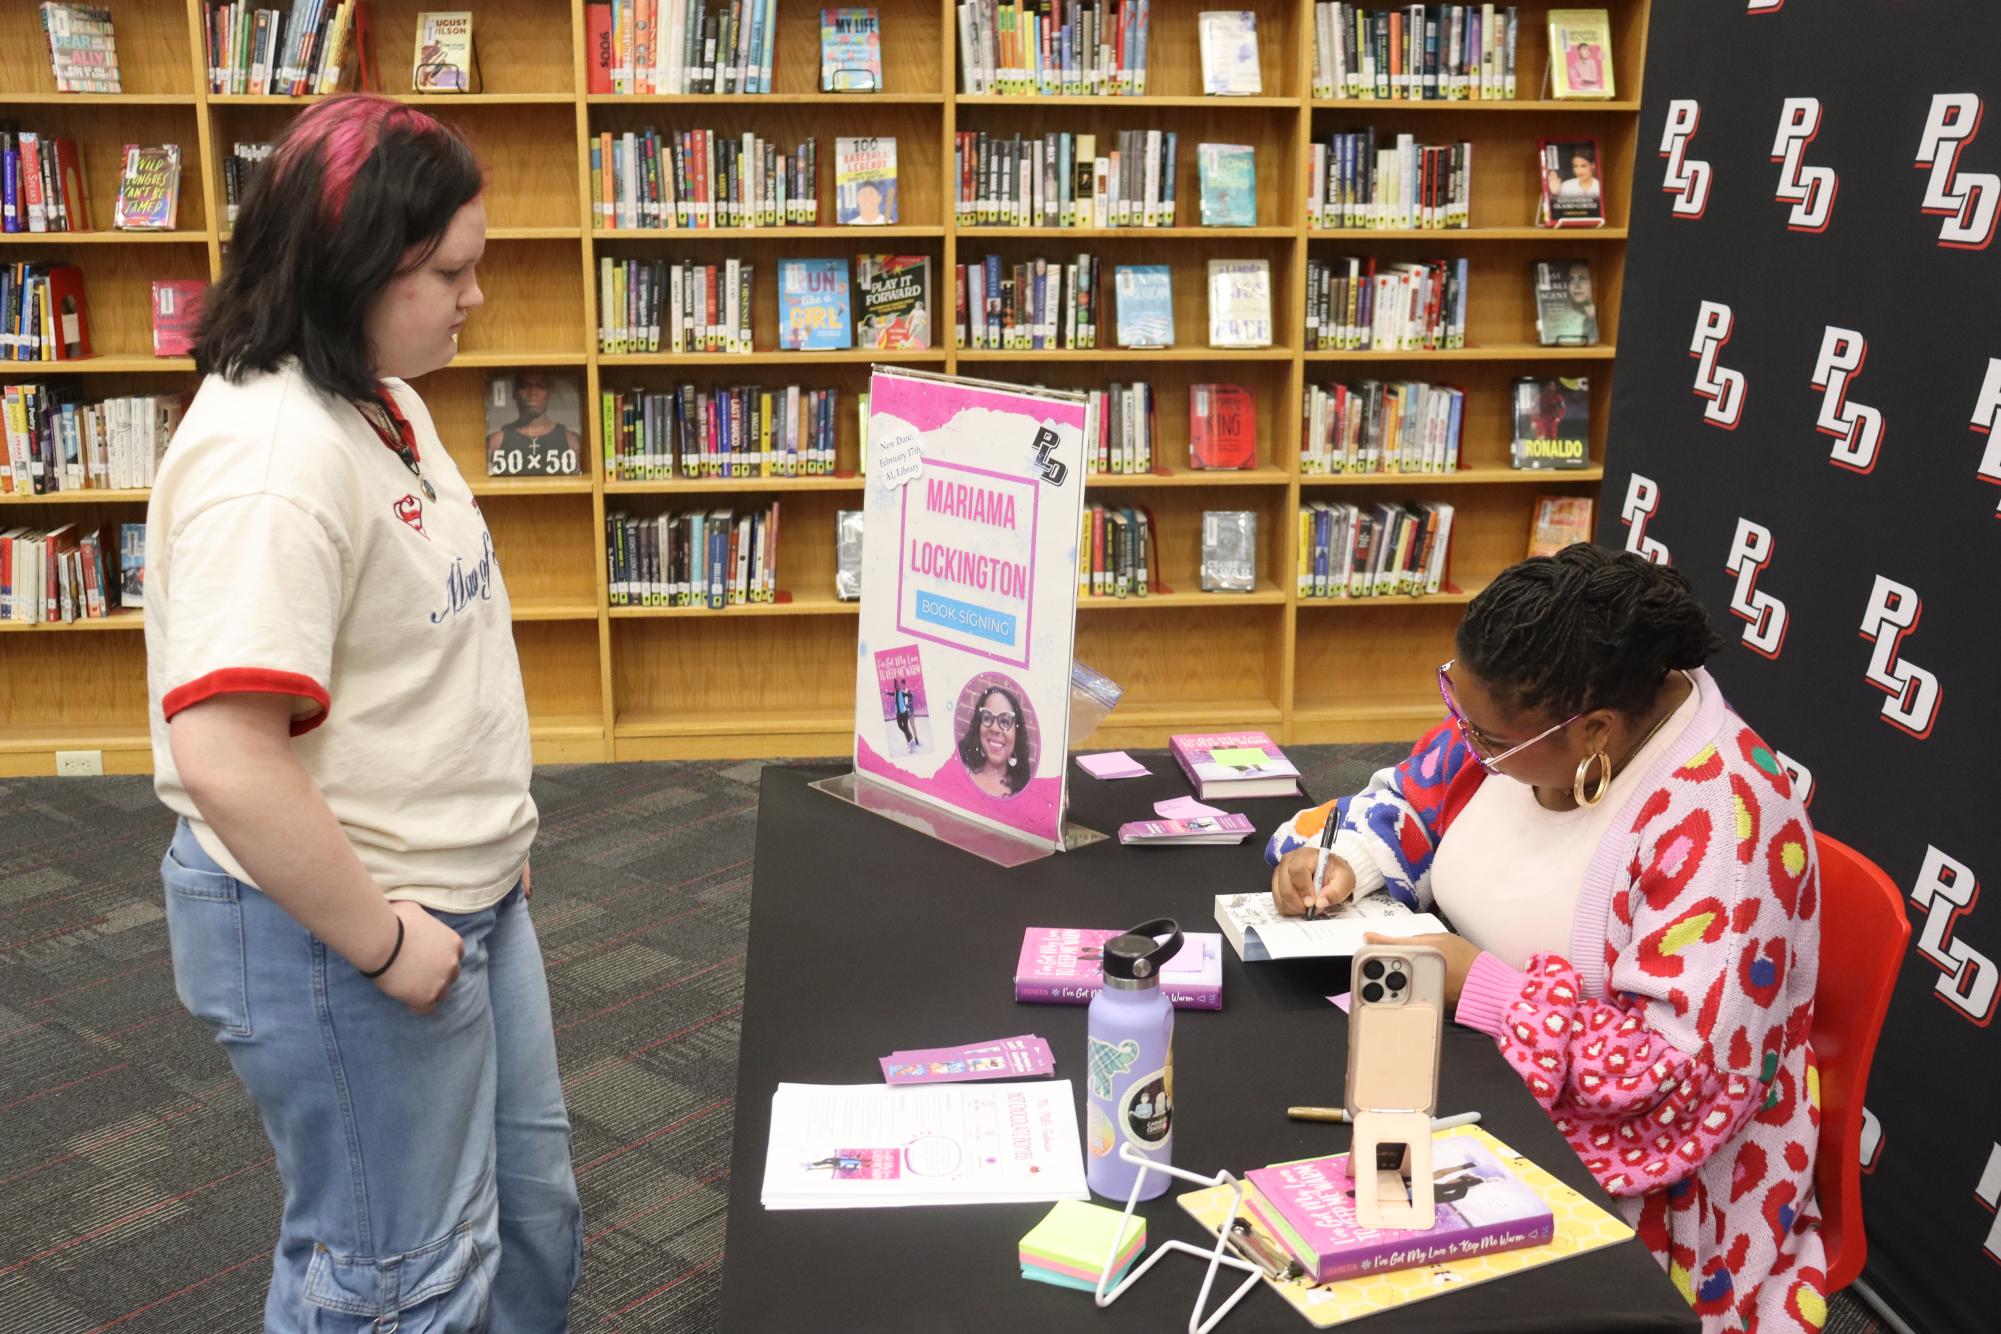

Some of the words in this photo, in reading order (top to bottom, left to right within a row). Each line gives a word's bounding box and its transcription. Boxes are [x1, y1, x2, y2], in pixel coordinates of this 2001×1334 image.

[433, 18, 467, 26] UGUST
[836, 18, 852, 33] MY
[855, 17, 875, 33] LIFE
[71, 50, 104, 65] ALLY
[600, 31, 610, 68] 900s
[853, 138, 878, 152] 100
[1047, 146, 1055, 163] SIX
[1659, 99, 1713, 219] PLD
[1770, 97, 1839, 234] PLD
[1914, 93, 2001, 250] PLD
[151, 187, 166, 200] BE
[1329, 164, 1337, 203] NEYMAR
[126, 200, 162, 214] TAMED
[865, 285, 922, 306] FORWARD
[872, 278, 898, 294] PLAY
[900, 276, 913, 288] IT
[790, 306, 843, 329] GIRL
[1690, 300, 1747, 431] PLD
[730, 399, 740, 420] LAST
[1810, 325, 1885, 475] PLD
[1206, 412, 1240, 436] KING
[880, 442, 894, 450] New
[896, 434, 914, 445] Date:
[1525, 440, 1583, 458] RONALDO
[492, 449, 523, 474] 50
[546, 449, 576, 474] 50
[880, 452, 906, 468] February
[908, 446, 922, 457] 17th
[1031, 426, 1067, 487] PLD
[896, 464, 919, 477] Library
[926, 478, 1016, 530] MARIAMA
[911, 538, 1027, 600] LOCKINGTON
[1726, 516, 1788, 660] PLD
[922, 599, 957, 620] BOOK
[959, 610, 1010, 636] SIGNING
[1859, 573, 1942, 741] PLD
[1910, 843, 2000, 1028] PLD
[1062, 988, 1075, 998] I've
[1076, 988, 1088, 998] Got
[1090, 988, 1103, 998] M
[1172, 992, 1194, 1002] Warm
[1009, 1104, 1030, 1136] CHOCOLATE
[1280, 1170, 1306, 1189] Love
[1292, 1164, 1334, 1190] WARM
[1294, 1190, 1326, 1211] My
[1310, 1211, 1343, 1228] Got
[1330, 1228, 1356, 1245] I've
[1352, 1229, 1380, 1241] TO
[1374, 1255, 1388, 1268] I've
[1390, 1250, 1404, 1266] Got
[1407, 1250, 1426, 1264] My
[1428, 1246, 1446, 1260] Love
[1448, 1243, 1458, 1254] to
[1460, 1238, 1479, 1254] Keep
[1480, 1234, 1498, 1248] Me
[1500, 1231, 1524, 1246] Warm
